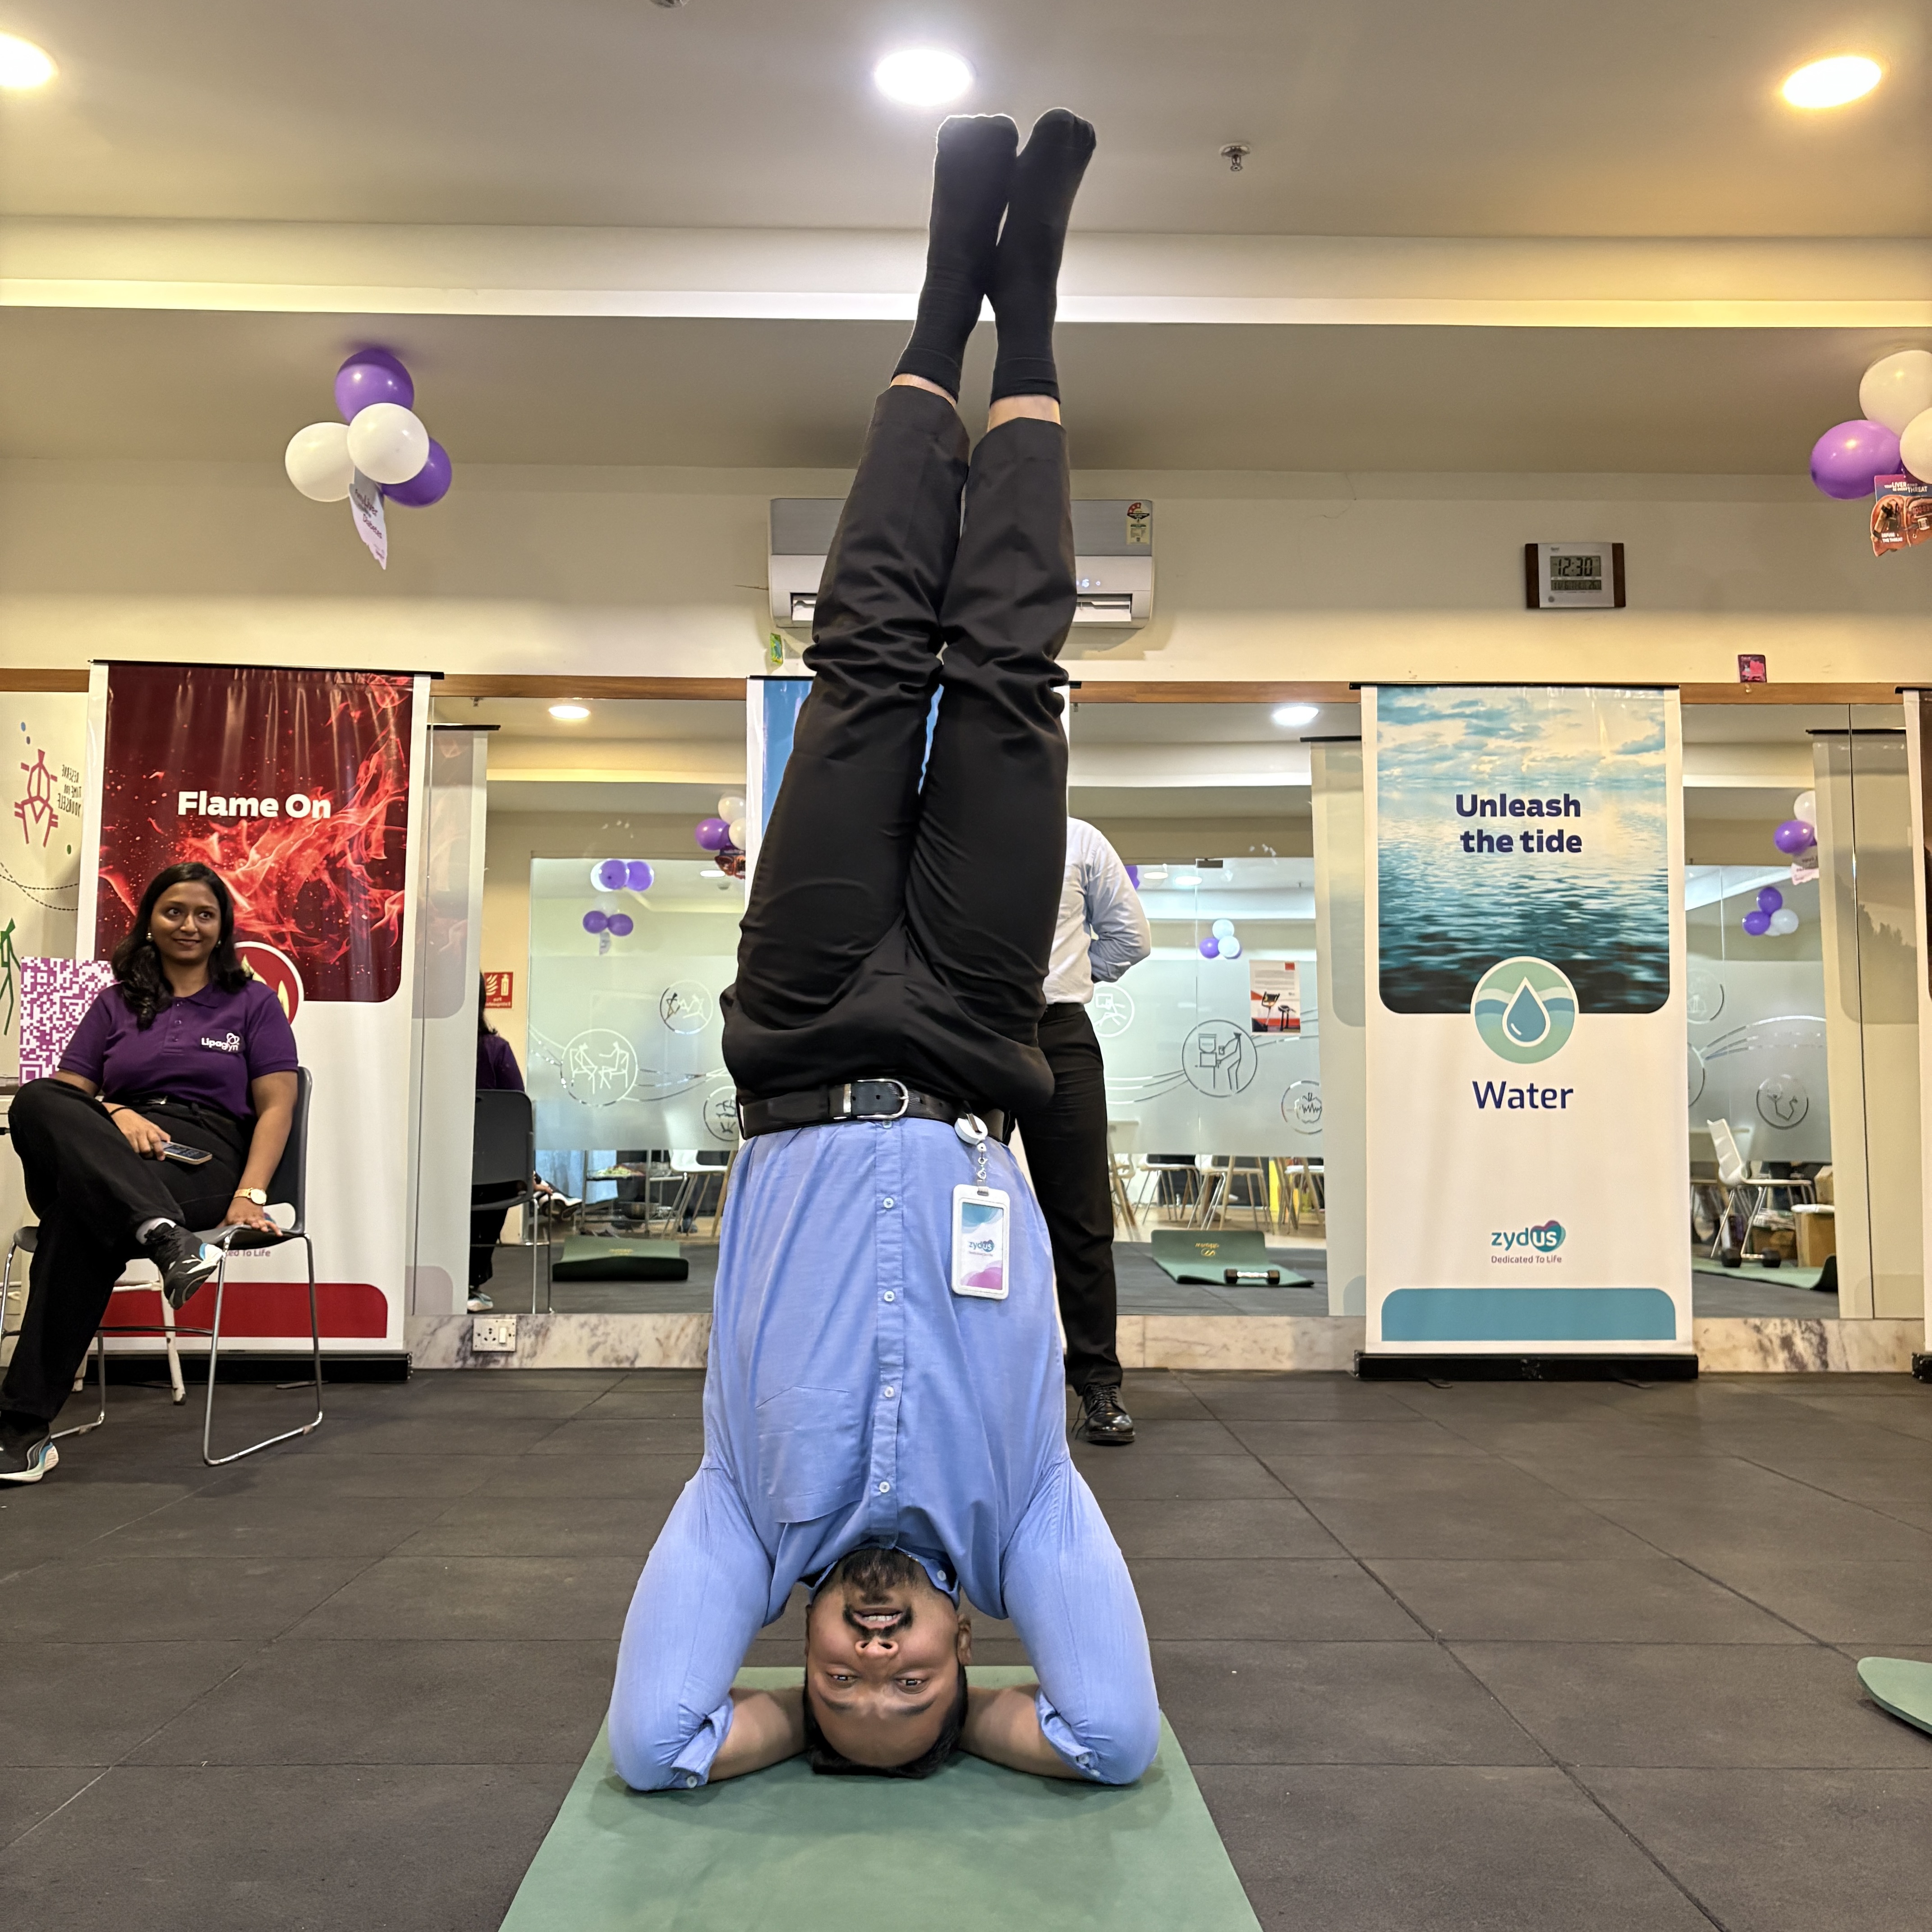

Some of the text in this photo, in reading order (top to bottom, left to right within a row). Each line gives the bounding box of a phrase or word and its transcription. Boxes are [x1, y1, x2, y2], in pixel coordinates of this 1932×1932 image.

[1558, 557, 1592, 577] 12:30
[179, 790, 331, 820] Flame On
[1456, 793, 1581, 818] Unleash
[1460, 829, 1582, 853] the tide
[1472, 1081, 1574, 1109] Water
[968, 1241, 993, 1250] zydus
[1491, 1226, 1558, 1251] zydus
[253, 1249, 271, 1257] Life
[1491, 1255, 1562, 1264] Dedicated To Life
